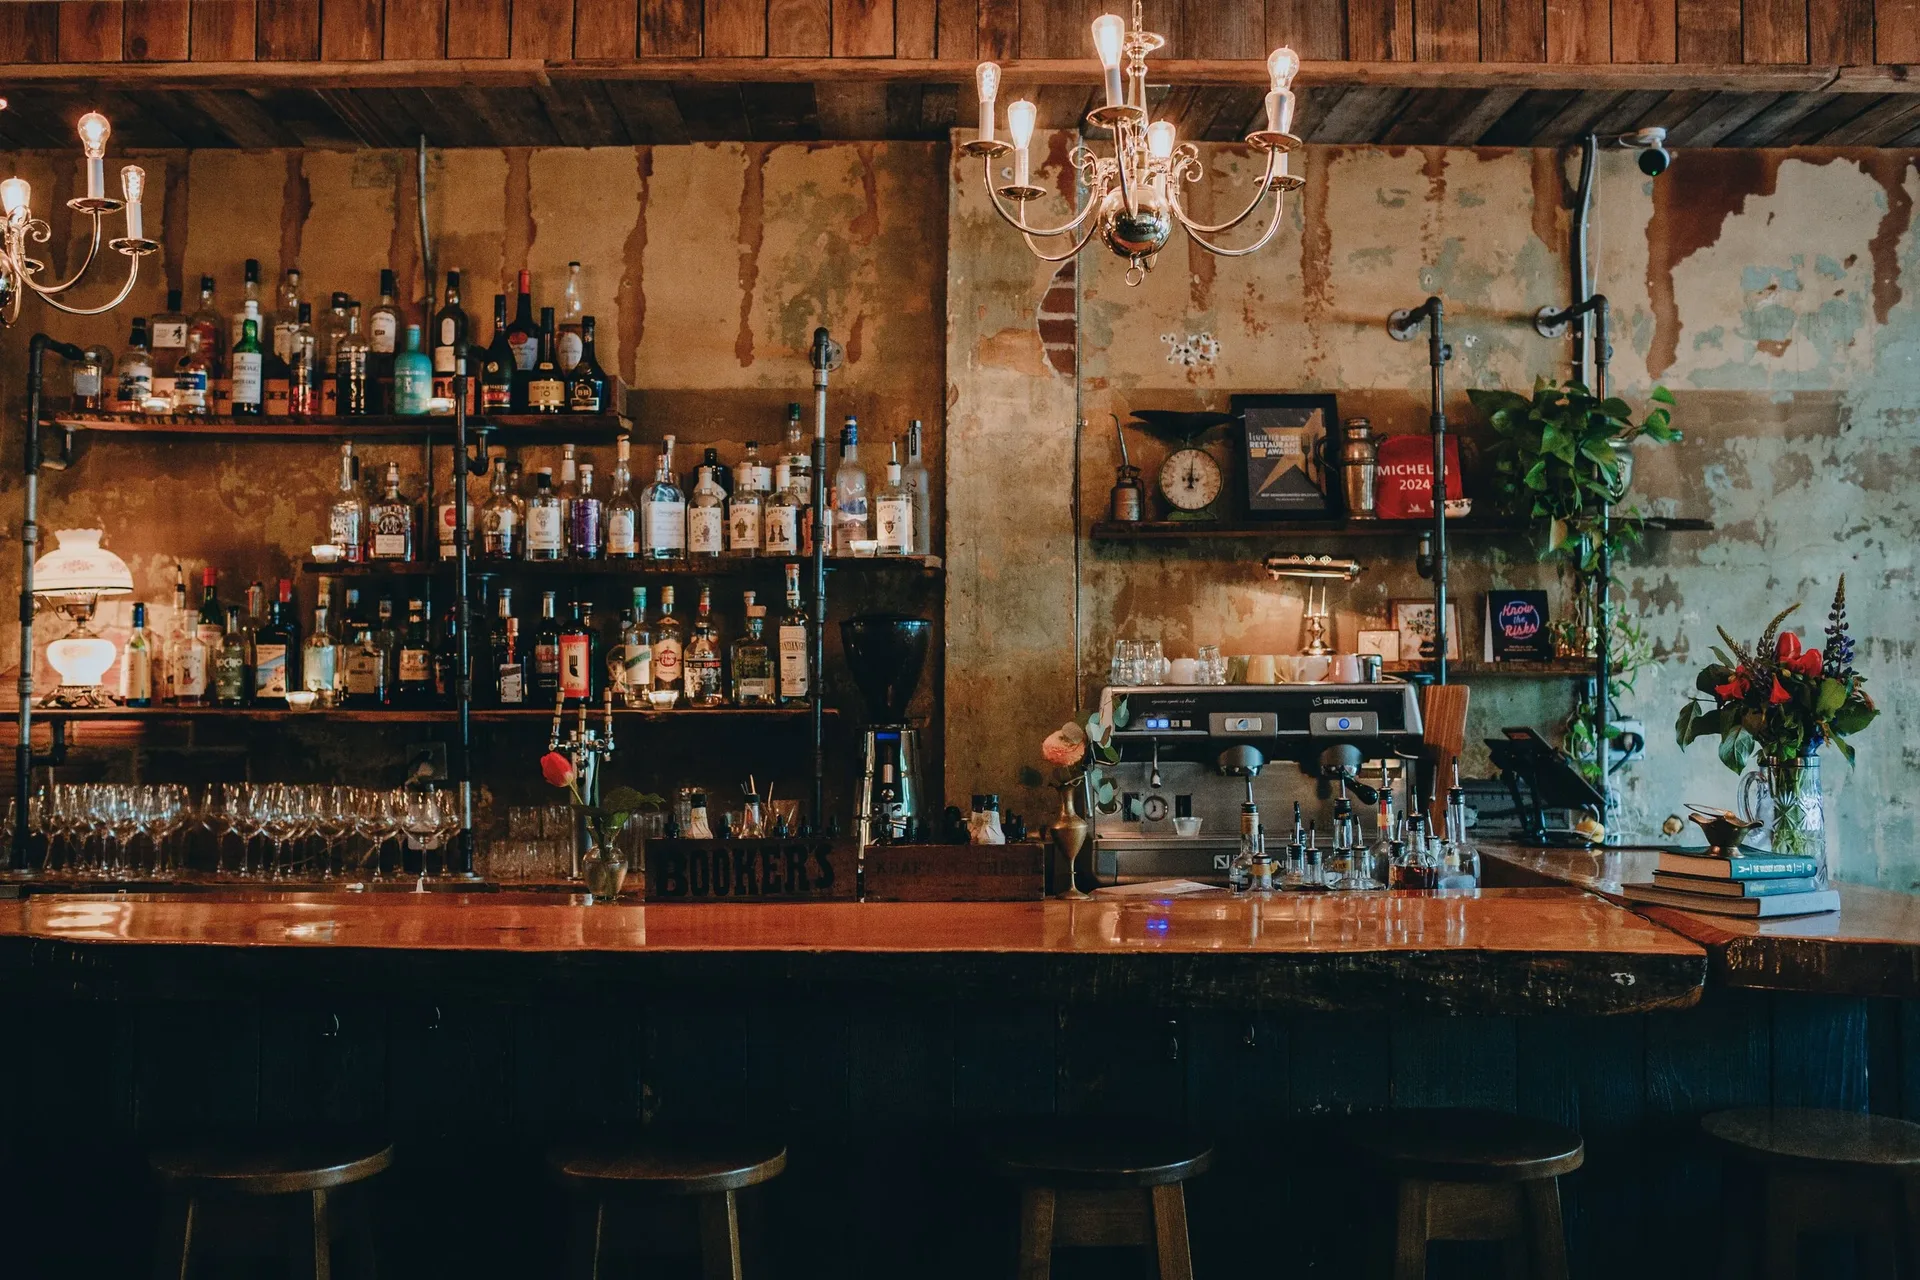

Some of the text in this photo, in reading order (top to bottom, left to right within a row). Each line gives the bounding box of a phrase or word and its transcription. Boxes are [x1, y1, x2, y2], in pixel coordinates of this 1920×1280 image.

[1377, 464, 1449, 476] MICHEL
[1400, 479, 1431, 490] 2024
[1503, 604, 1534, 616] Know
[1513, 615, 1526, 624] the
[1505, 622, 1537, 637] Risks
[656, 843, 835, 897] BOOKER'S
